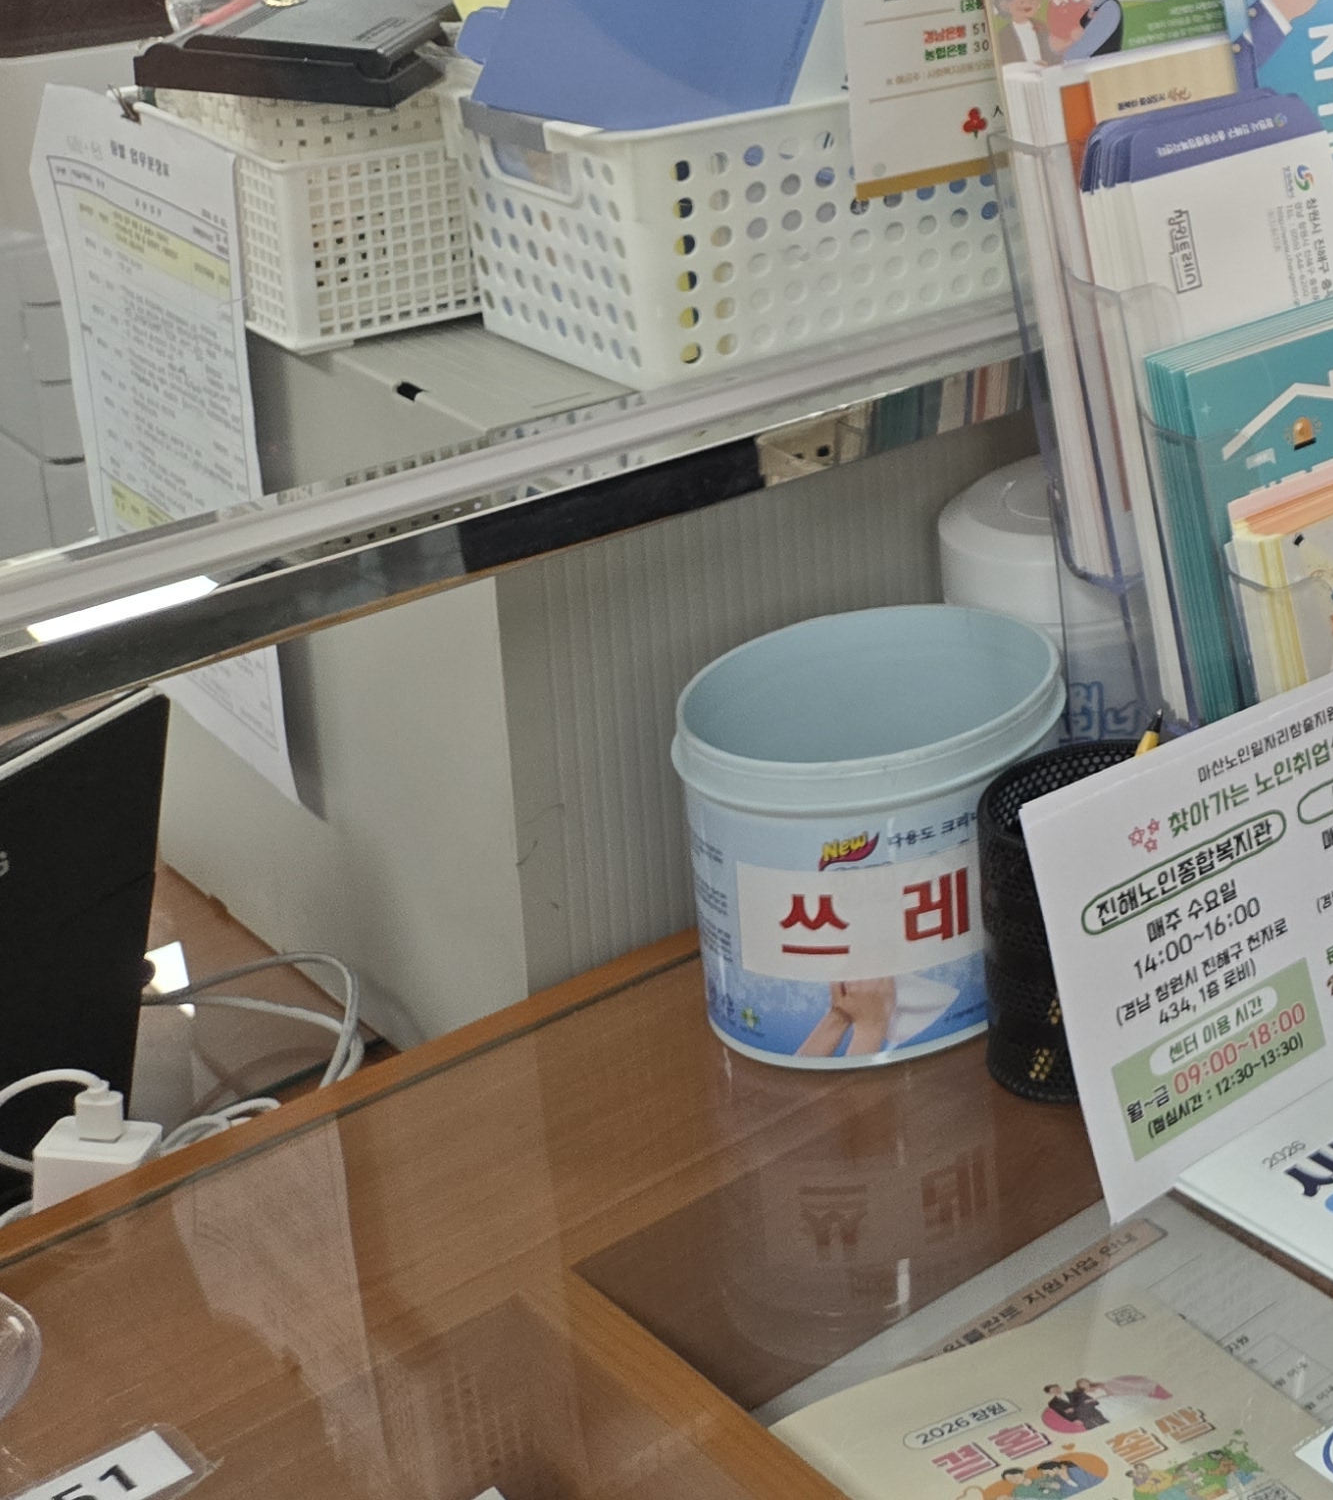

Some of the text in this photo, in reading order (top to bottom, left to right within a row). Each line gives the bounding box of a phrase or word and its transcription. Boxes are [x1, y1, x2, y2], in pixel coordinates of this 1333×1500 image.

[887, 826, 936, 848] 다용도
[1168, 782, 1249, 837] 찾아가는
[821, 832, 868, 861] New
[1095, 819, 1273, 926] 진해노인종합복지관
[1134, 897, 1260, 979] 14:00~16:00
[1146, 879, 1238, 942] 매주 수요일
[1155, 966, 1199, 1003] 창원시
[1201, 942, 1243, 977] 진해구
[1159, 997, 1197, 1024] 434,
[1223, 958, 1256, 990] 로비)
[1169, 996, 1264, 1063] 센터 이용 시간
[1126, 1003, 1306, 1124] 월~금 09:00~18:00
[1148, 1032, 1304, 1138] (점심시간 12:30~13:30)
[1020, 1255, 1099, 1305] 지원사업
[916, 1401, 1007, 1446] 2026 창원
[931, 1422, 1052, 1483] 결혼
